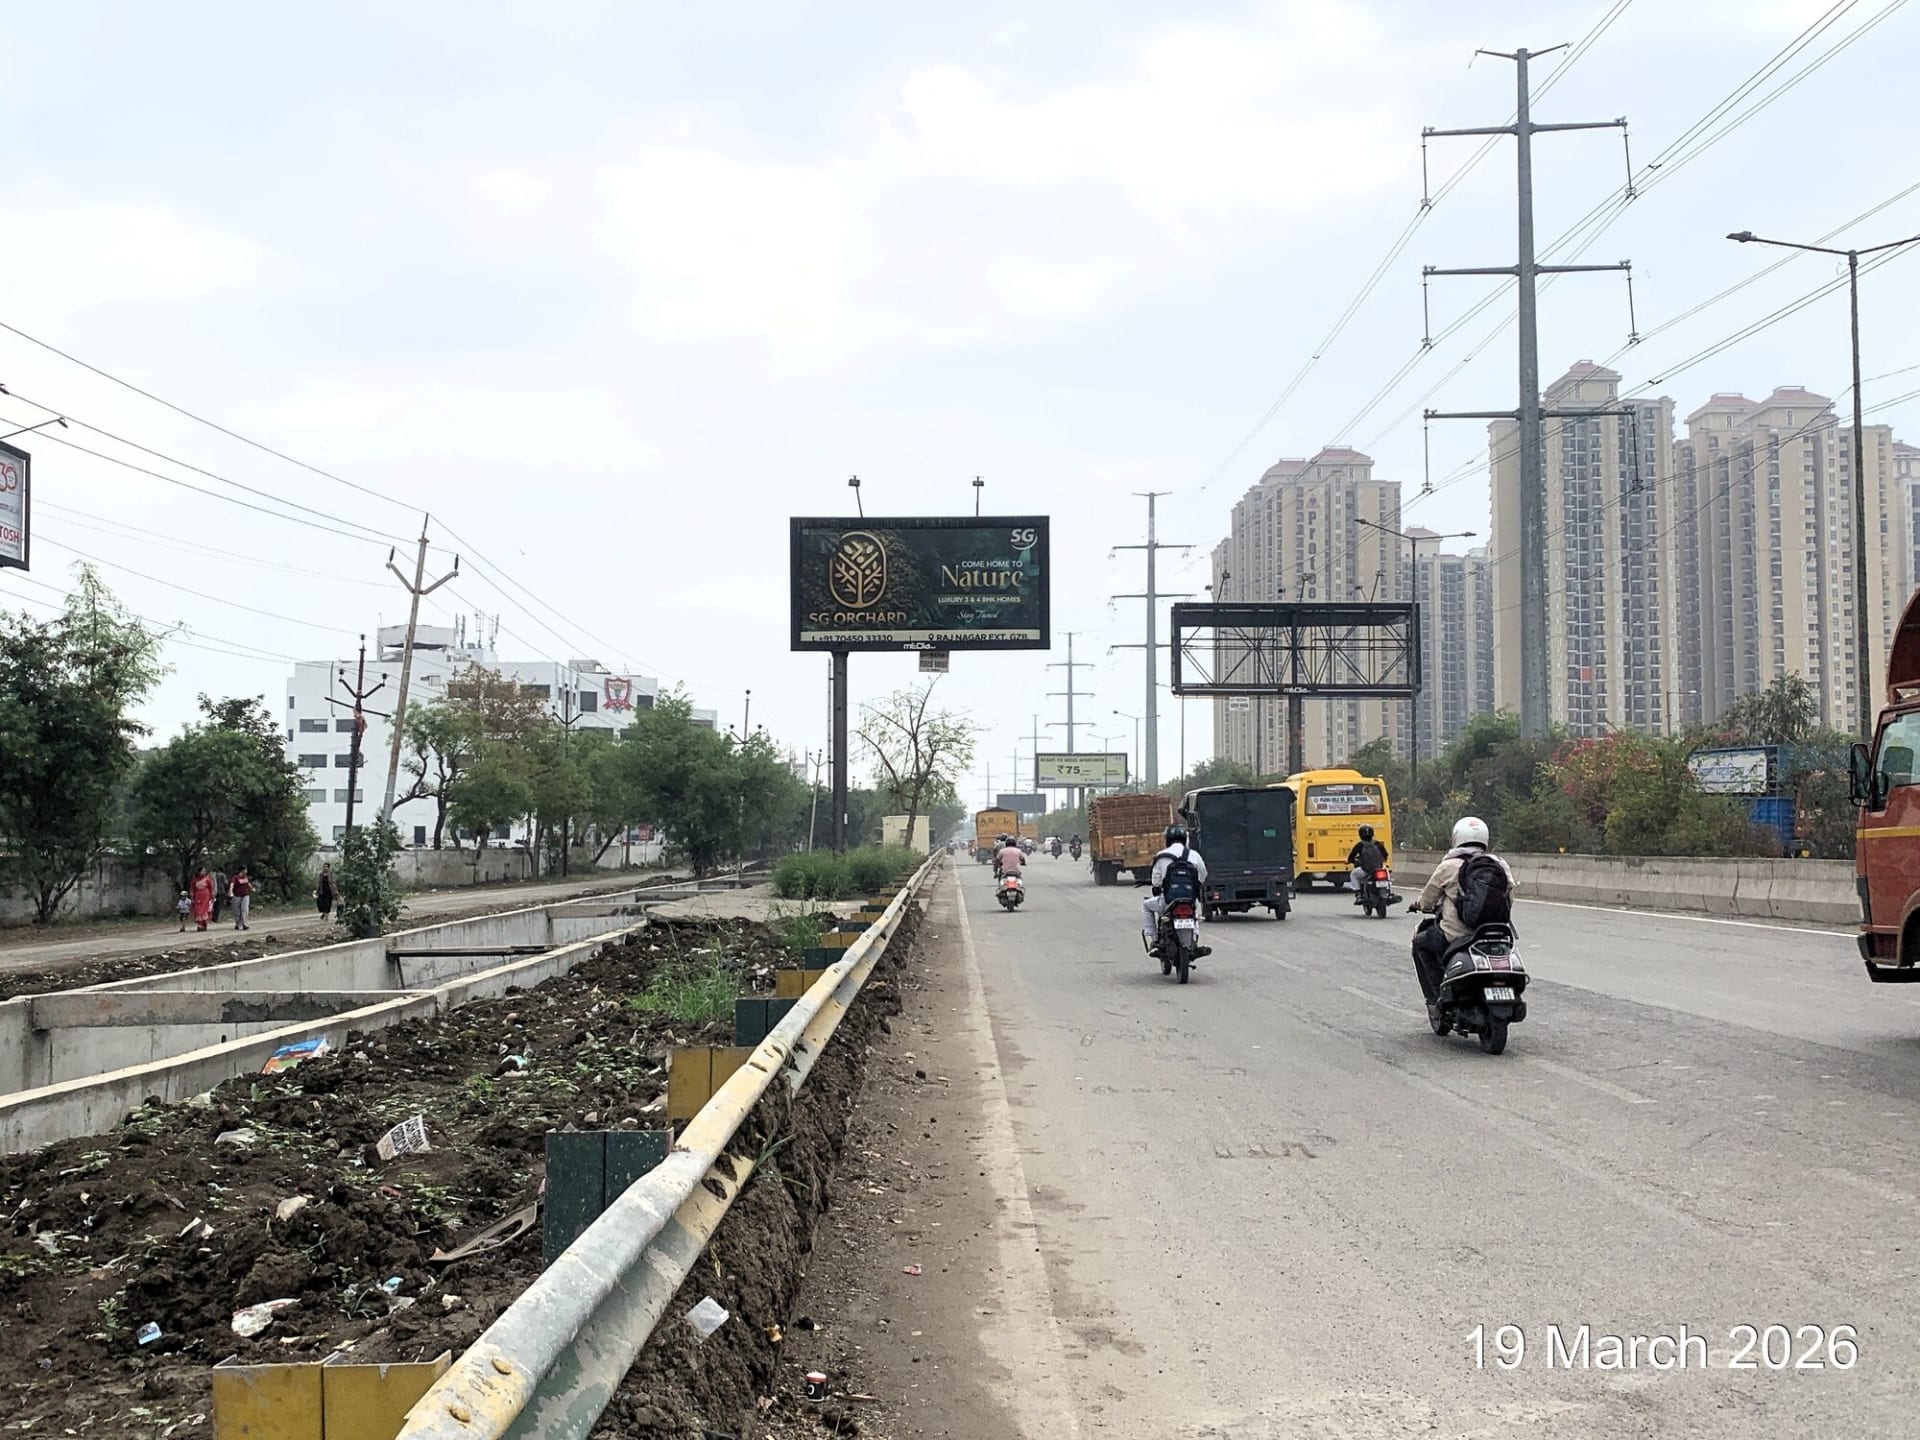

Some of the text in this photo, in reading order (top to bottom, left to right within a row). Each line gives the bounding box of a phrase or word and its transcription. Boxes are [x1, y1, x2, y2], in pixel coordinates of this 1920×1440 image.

[1010, 528, 1035, 542] SG
[961, 560, 1023, 568] COME HOME TO
[941, 565, 1024, 588] Nature
[809, 611, 907, 625] SG ORCHARD
[955, 633, 987, 641] NAGAR
